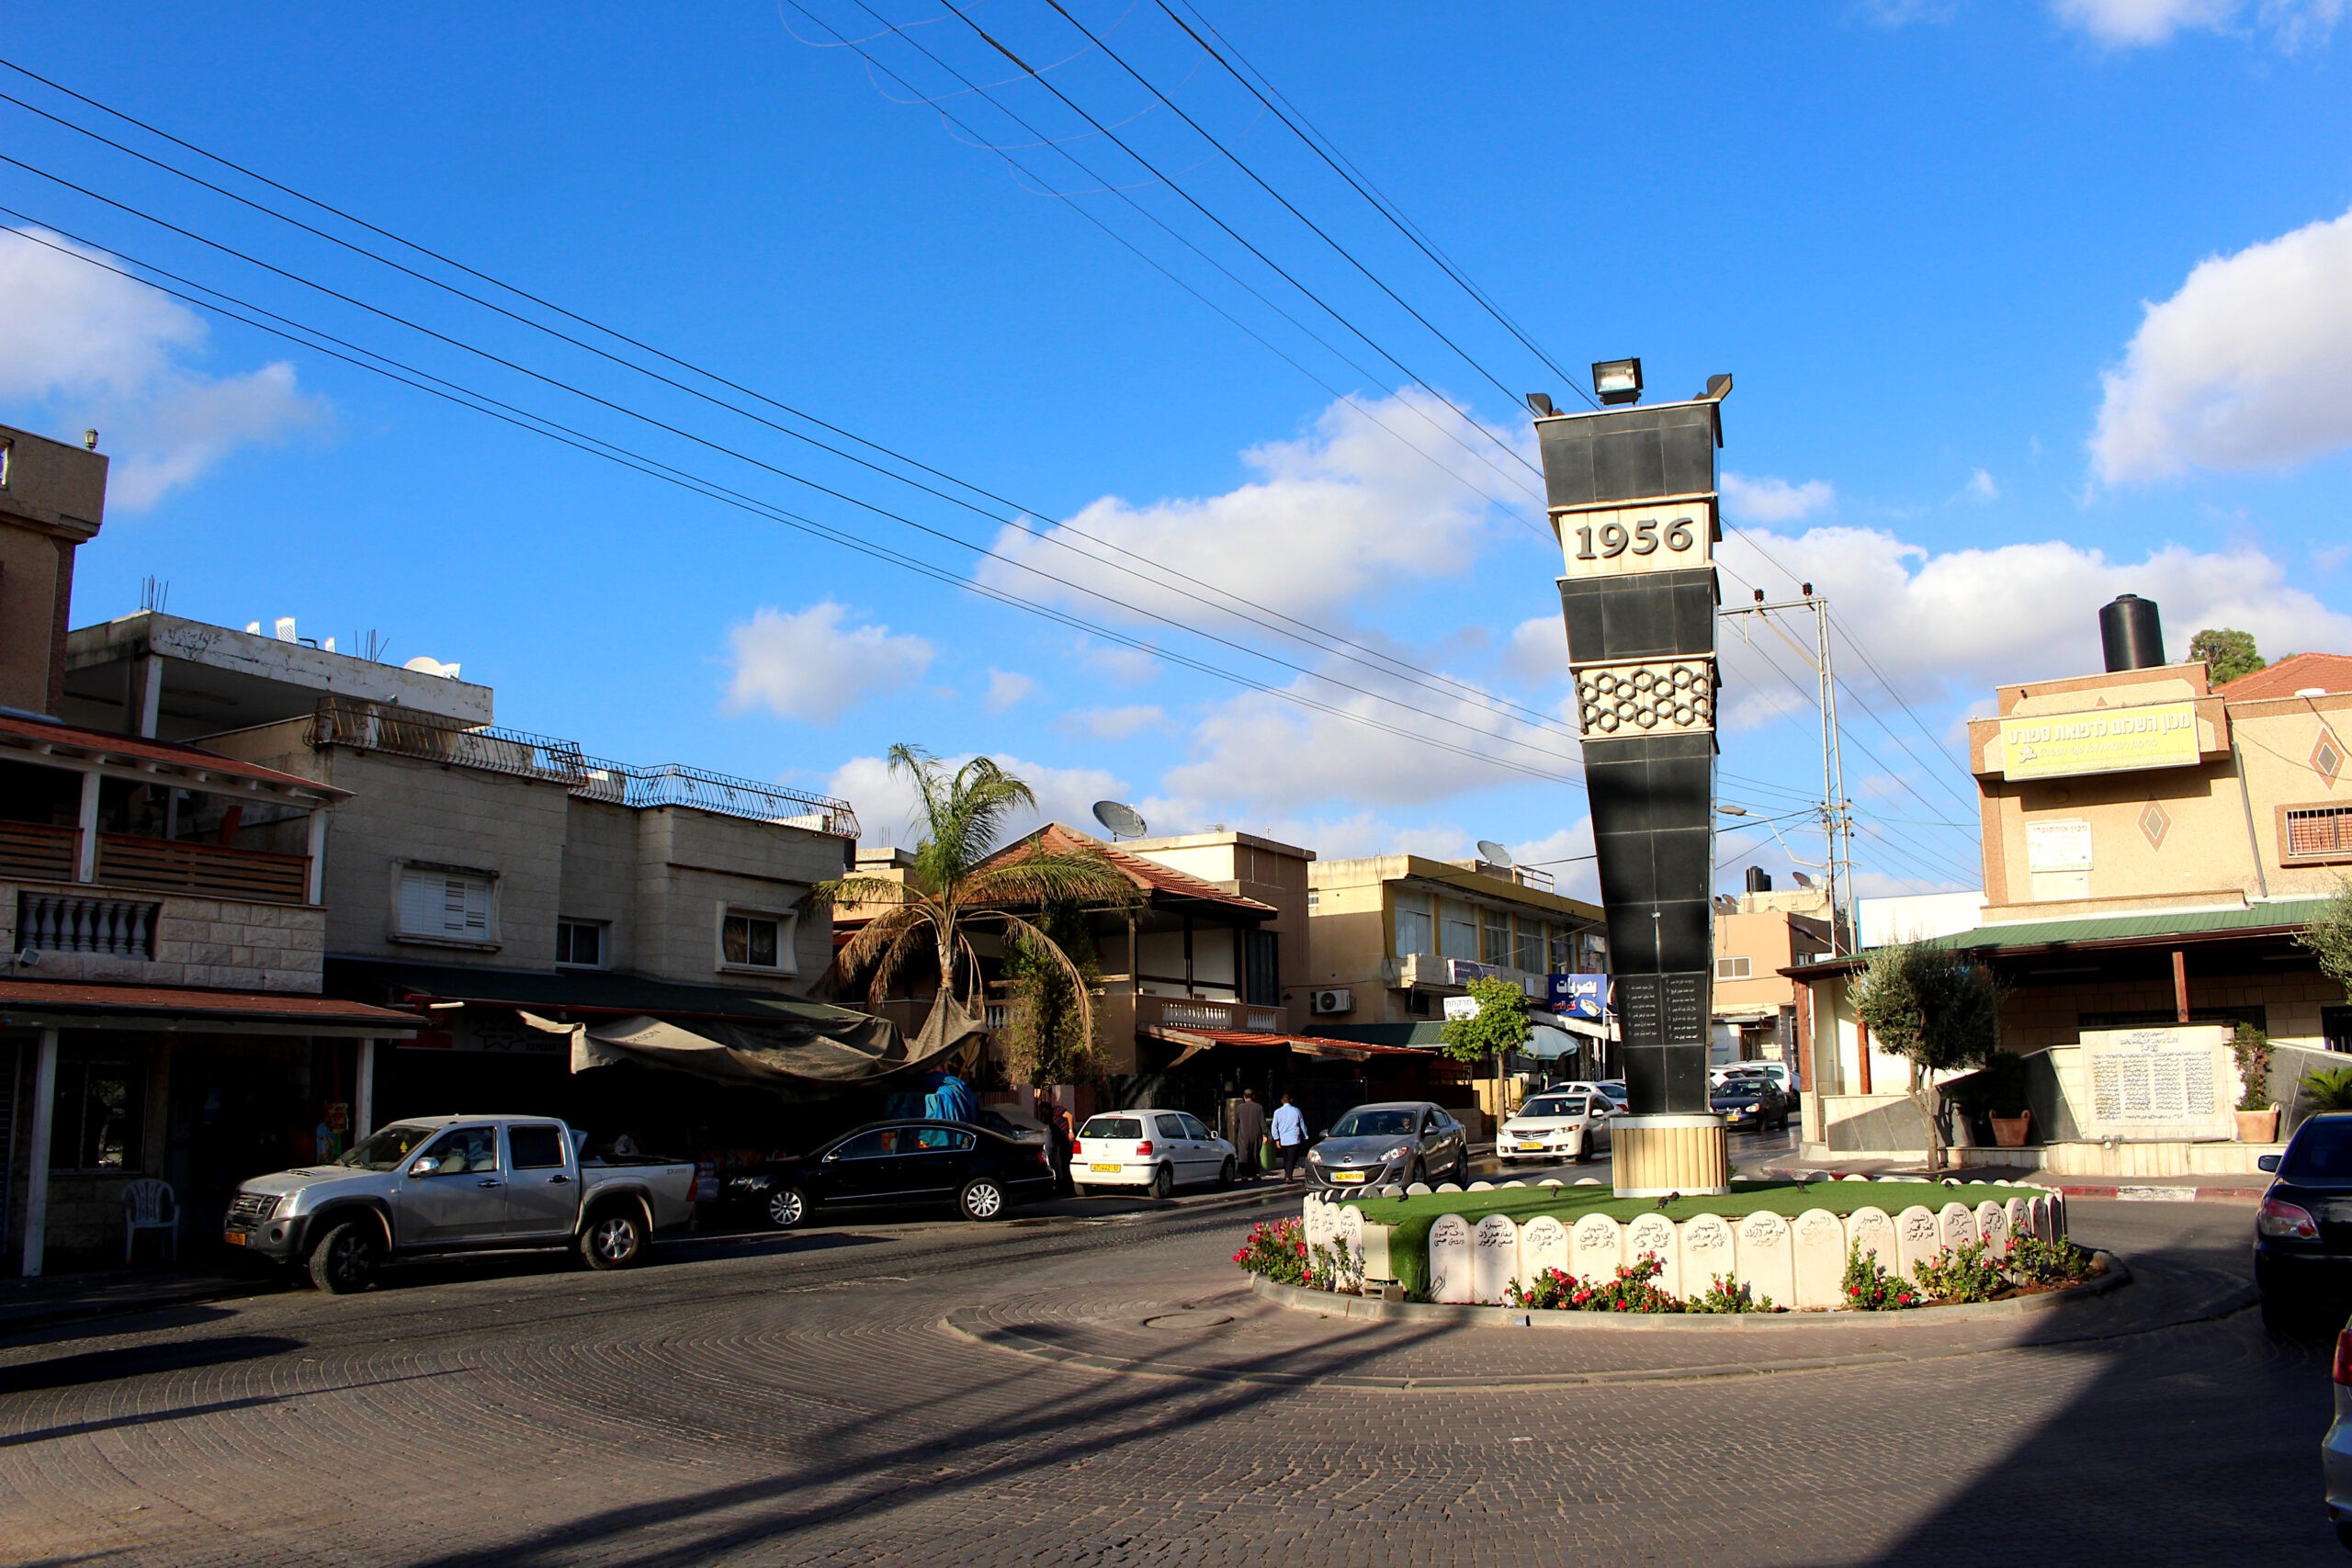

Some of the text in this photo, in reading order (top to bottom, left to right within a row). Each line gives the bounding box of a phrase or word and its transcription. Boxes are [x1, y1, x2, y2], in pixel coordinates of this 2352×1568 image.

[1576, 517, 1693, 559] 1956
[2112, 716, 2158, 736] השלום
[2161, 712, 2190, 736] מכון
[2008, 727, 2052, 745] ספורט
[1556, 977, 1598, 998] بصريات
